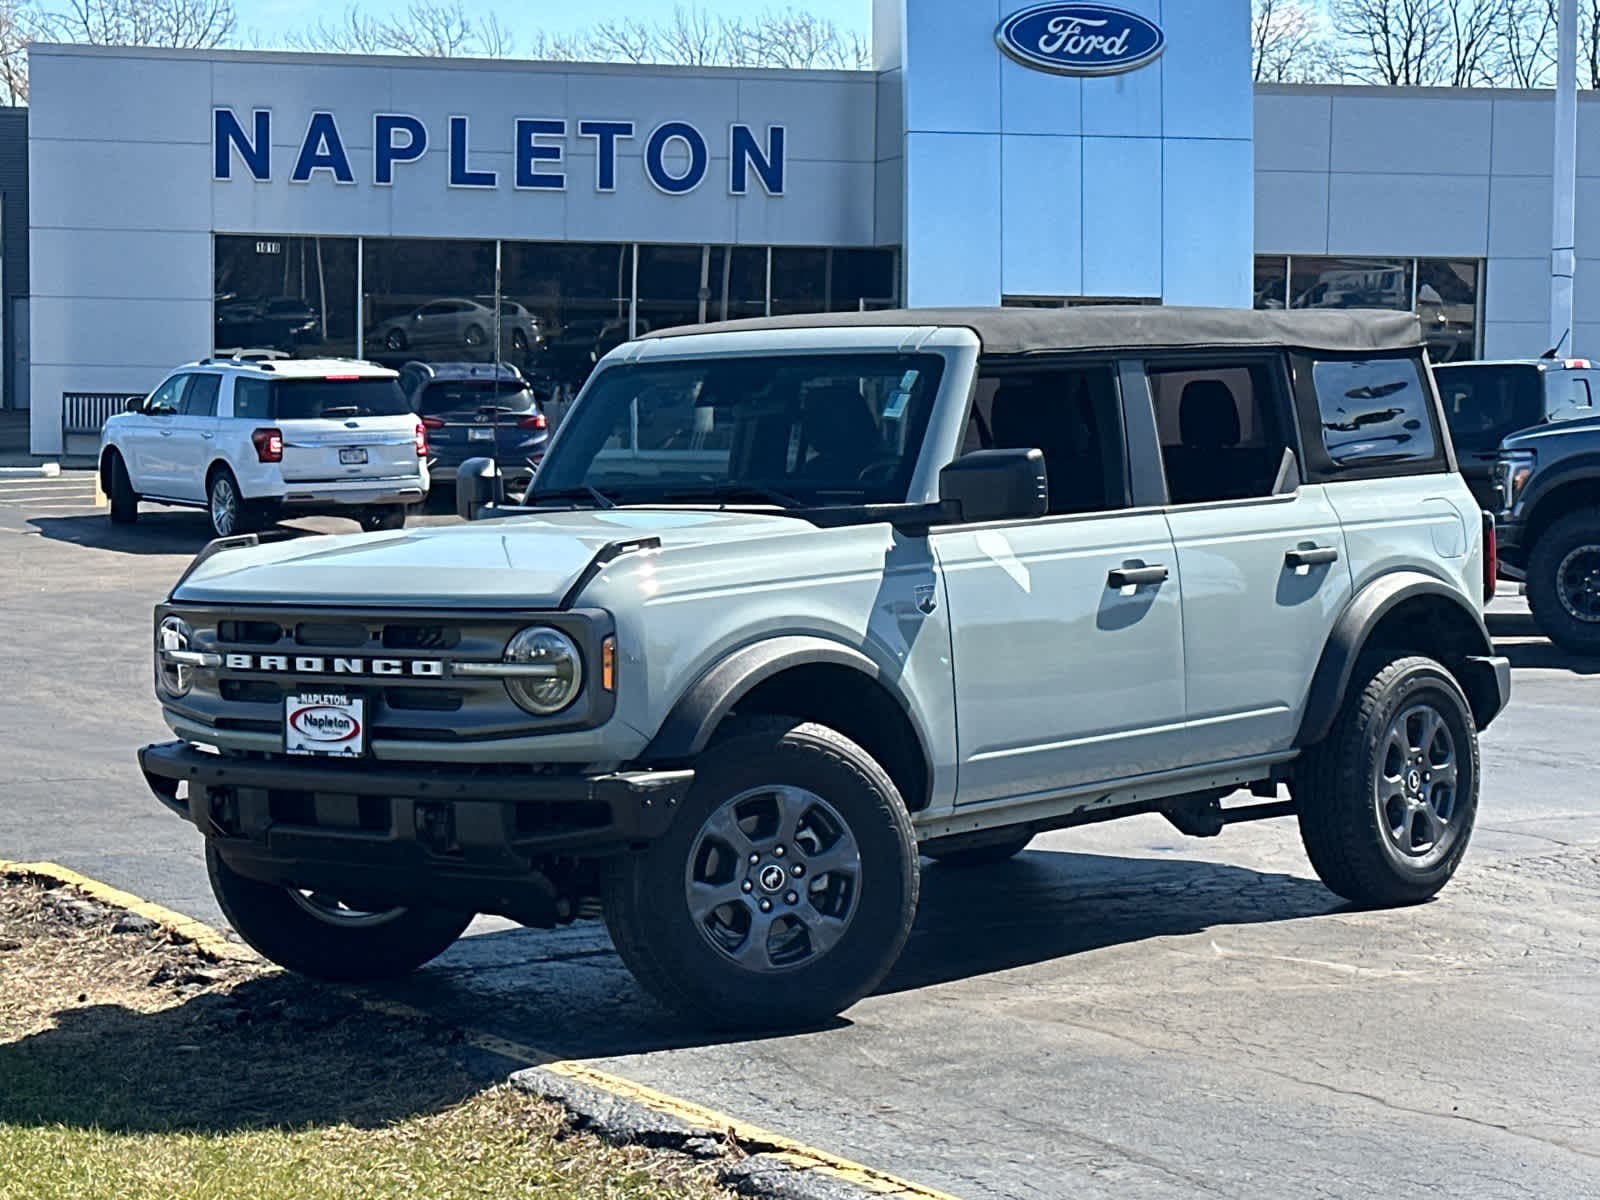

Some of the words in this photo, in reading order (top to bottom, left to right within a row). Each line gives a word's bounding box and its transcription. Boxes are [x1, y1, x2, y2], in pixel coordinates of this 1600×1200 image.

[1038, 16, 1131, 56] Ford
[212, 107, 786, 197] NAPLETON
[225, 653, 443, 676] BRONCO
[301, 693, 348, 705] NAPLETON
[304, 713, 350, 730] Napleton
